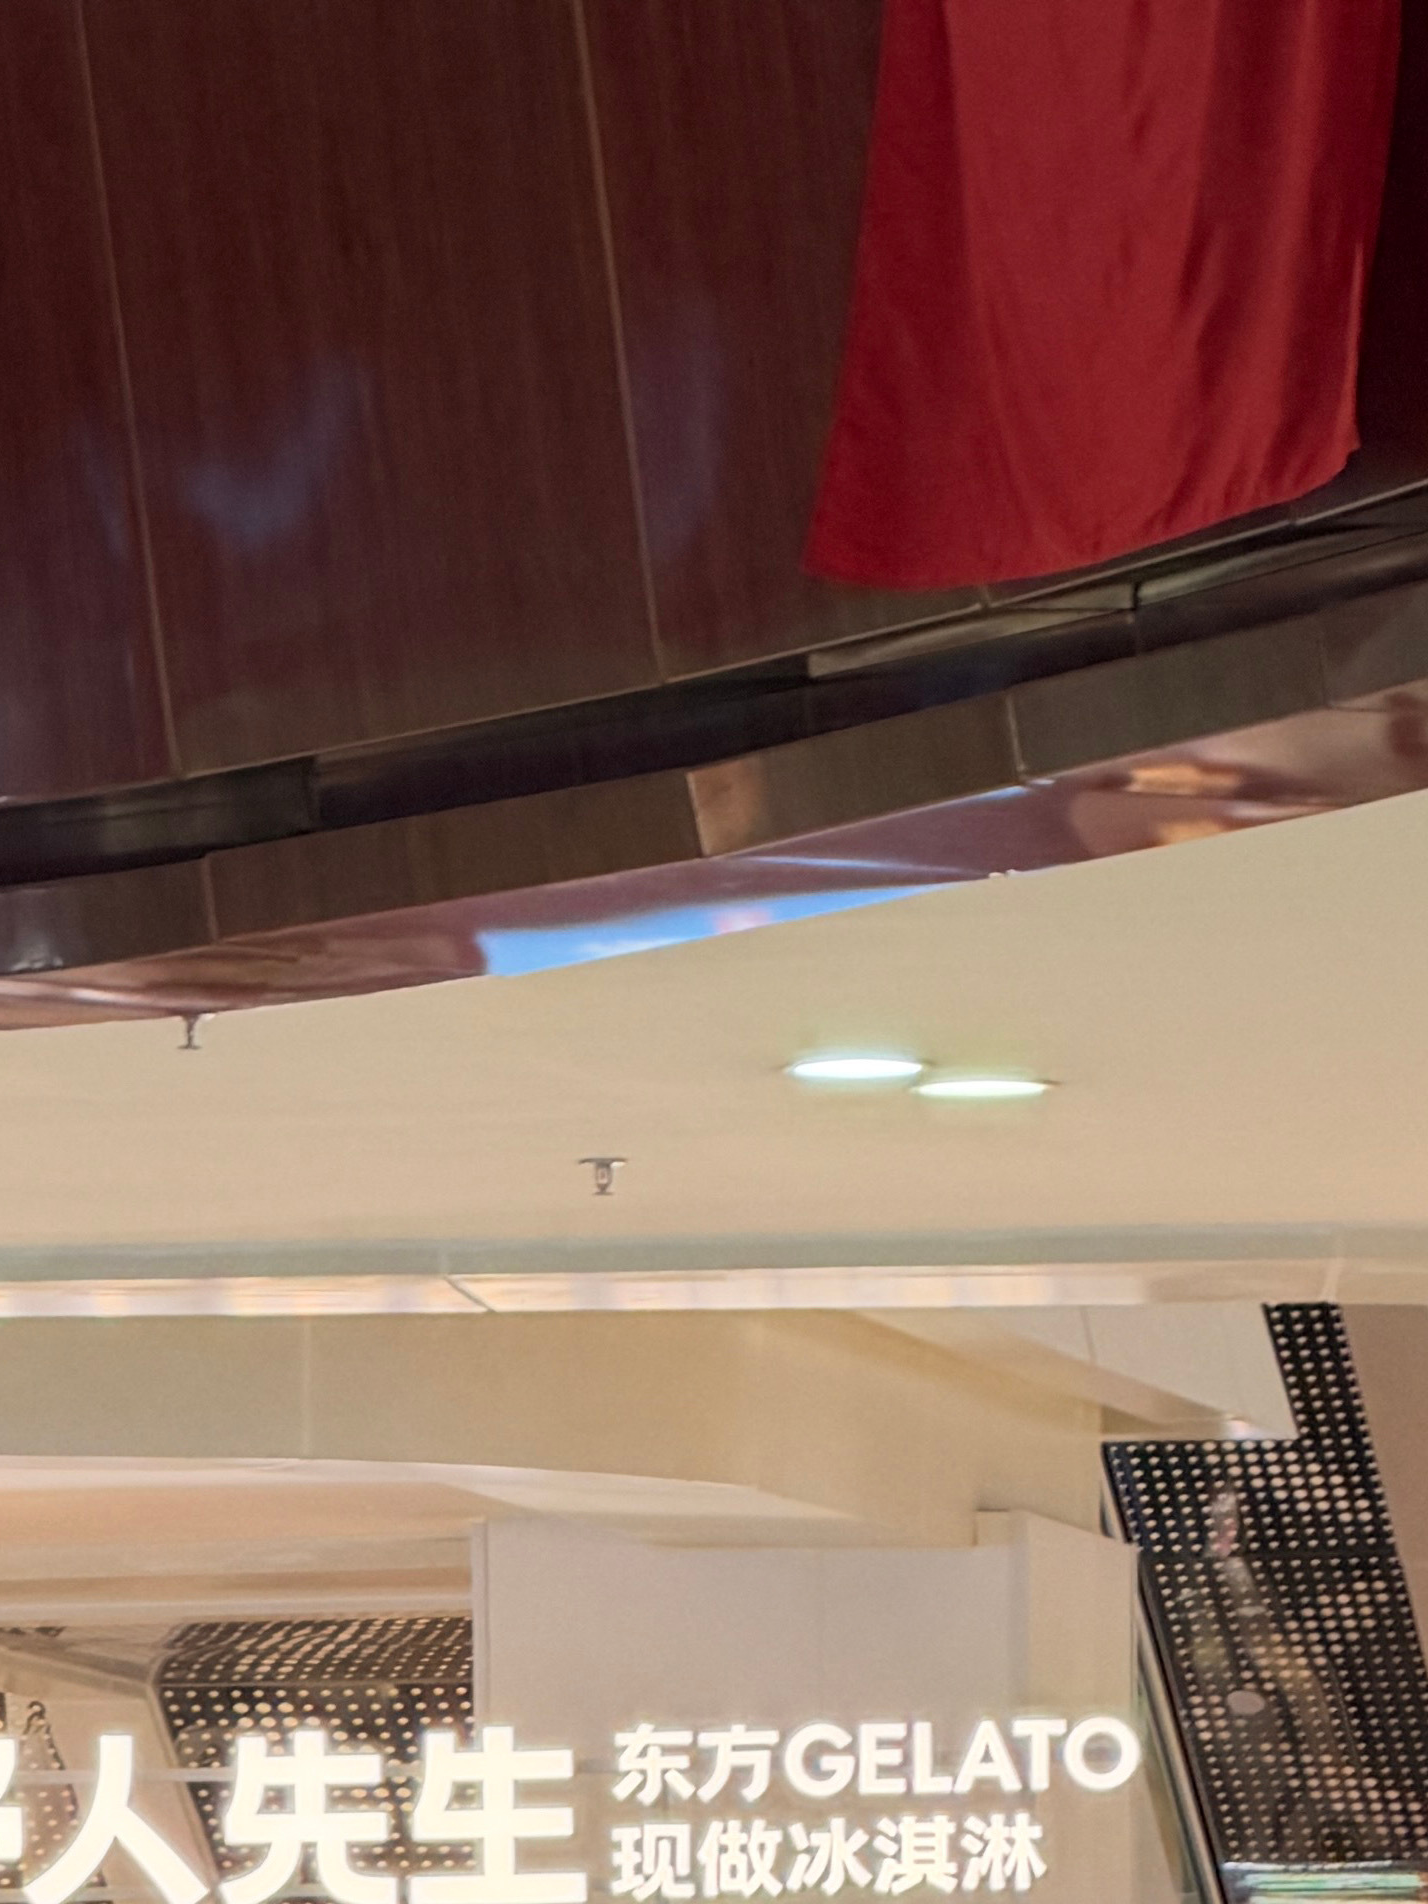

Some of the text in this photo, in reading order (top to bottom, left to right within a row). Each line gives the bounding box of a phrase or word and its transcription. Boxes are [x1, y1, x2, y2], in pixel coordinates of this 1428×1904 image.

[612, 1715, 1141, 1807] 东方GELATO
[610, 1811, 1048, 1902] 现做冰淇淋
